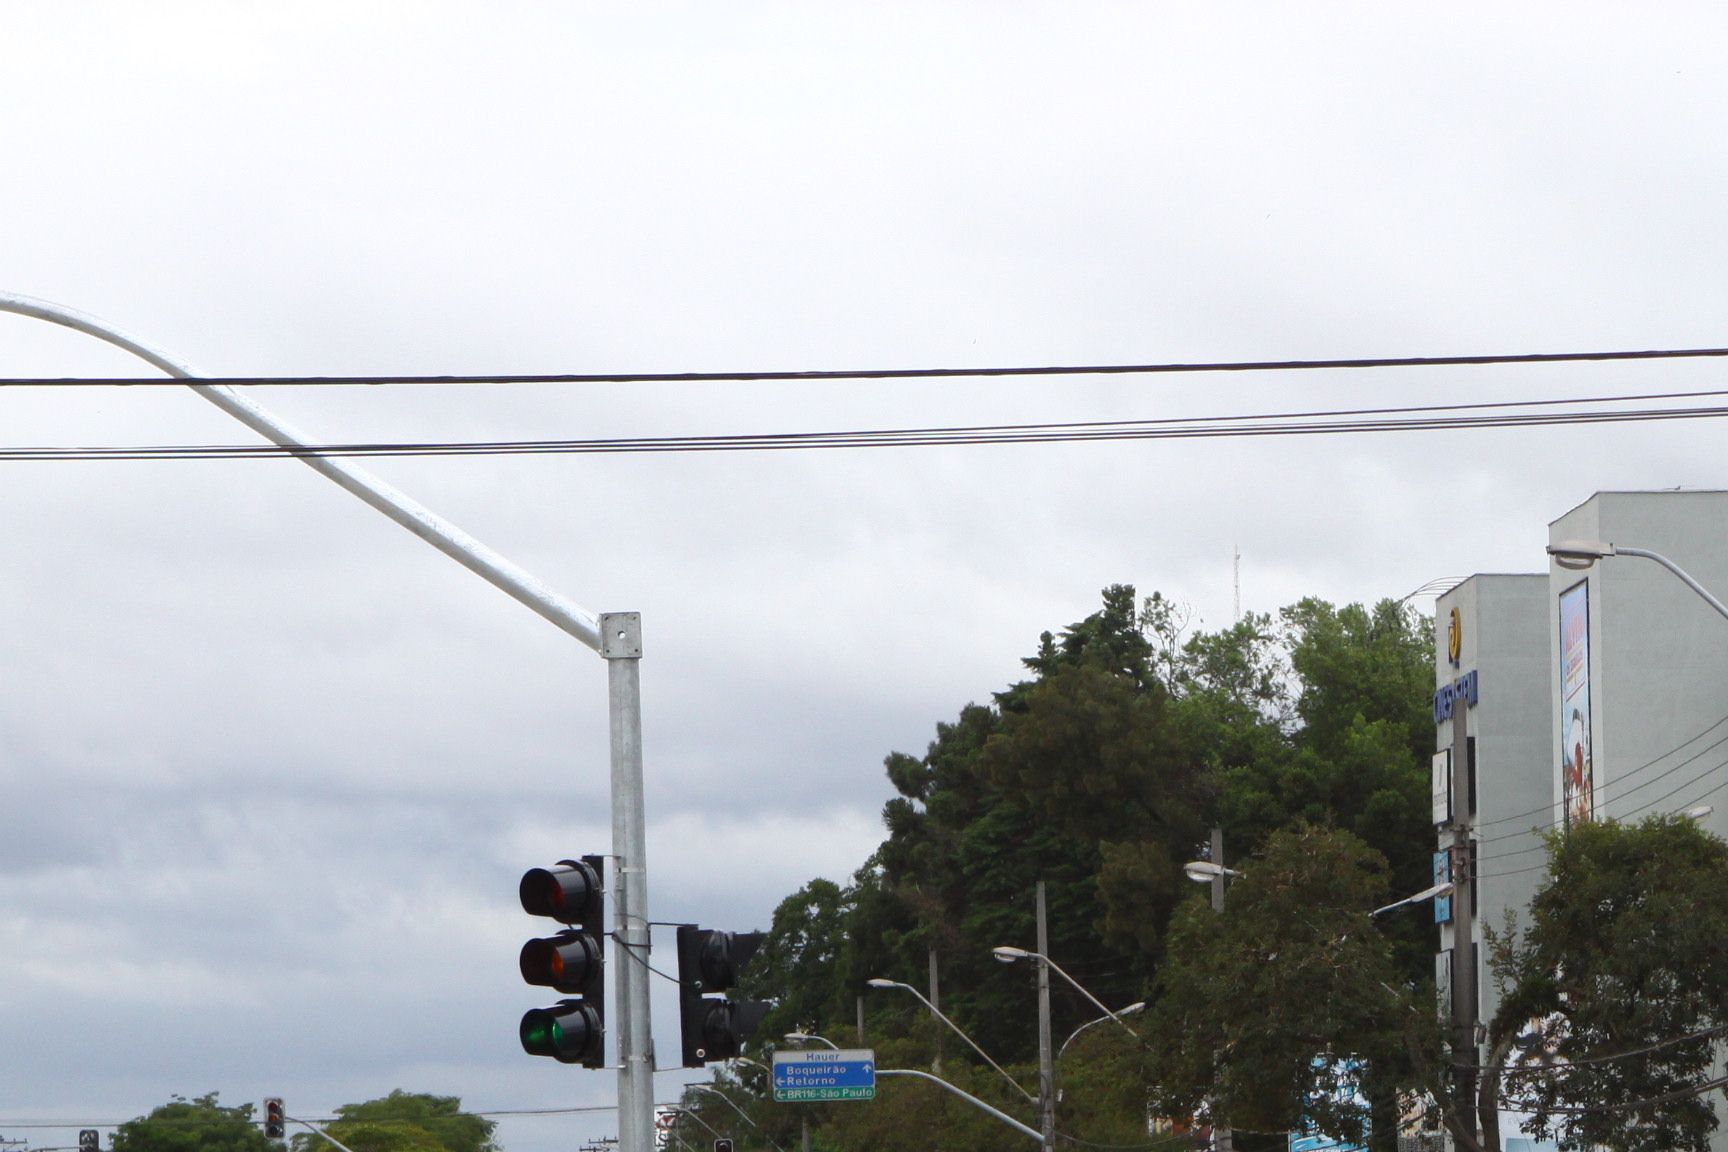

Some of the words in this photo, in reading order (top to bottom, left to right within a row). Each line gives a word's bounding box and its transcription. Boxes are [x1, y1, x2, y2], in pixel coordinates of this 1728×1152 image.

[806, 1052, 840, 1061] Hauer
[786, 1065, 847, 1076] Boqueirão
[786, 1076, 836, 1086] Retorno
[842, 1087, 873, 1098] Paulo
